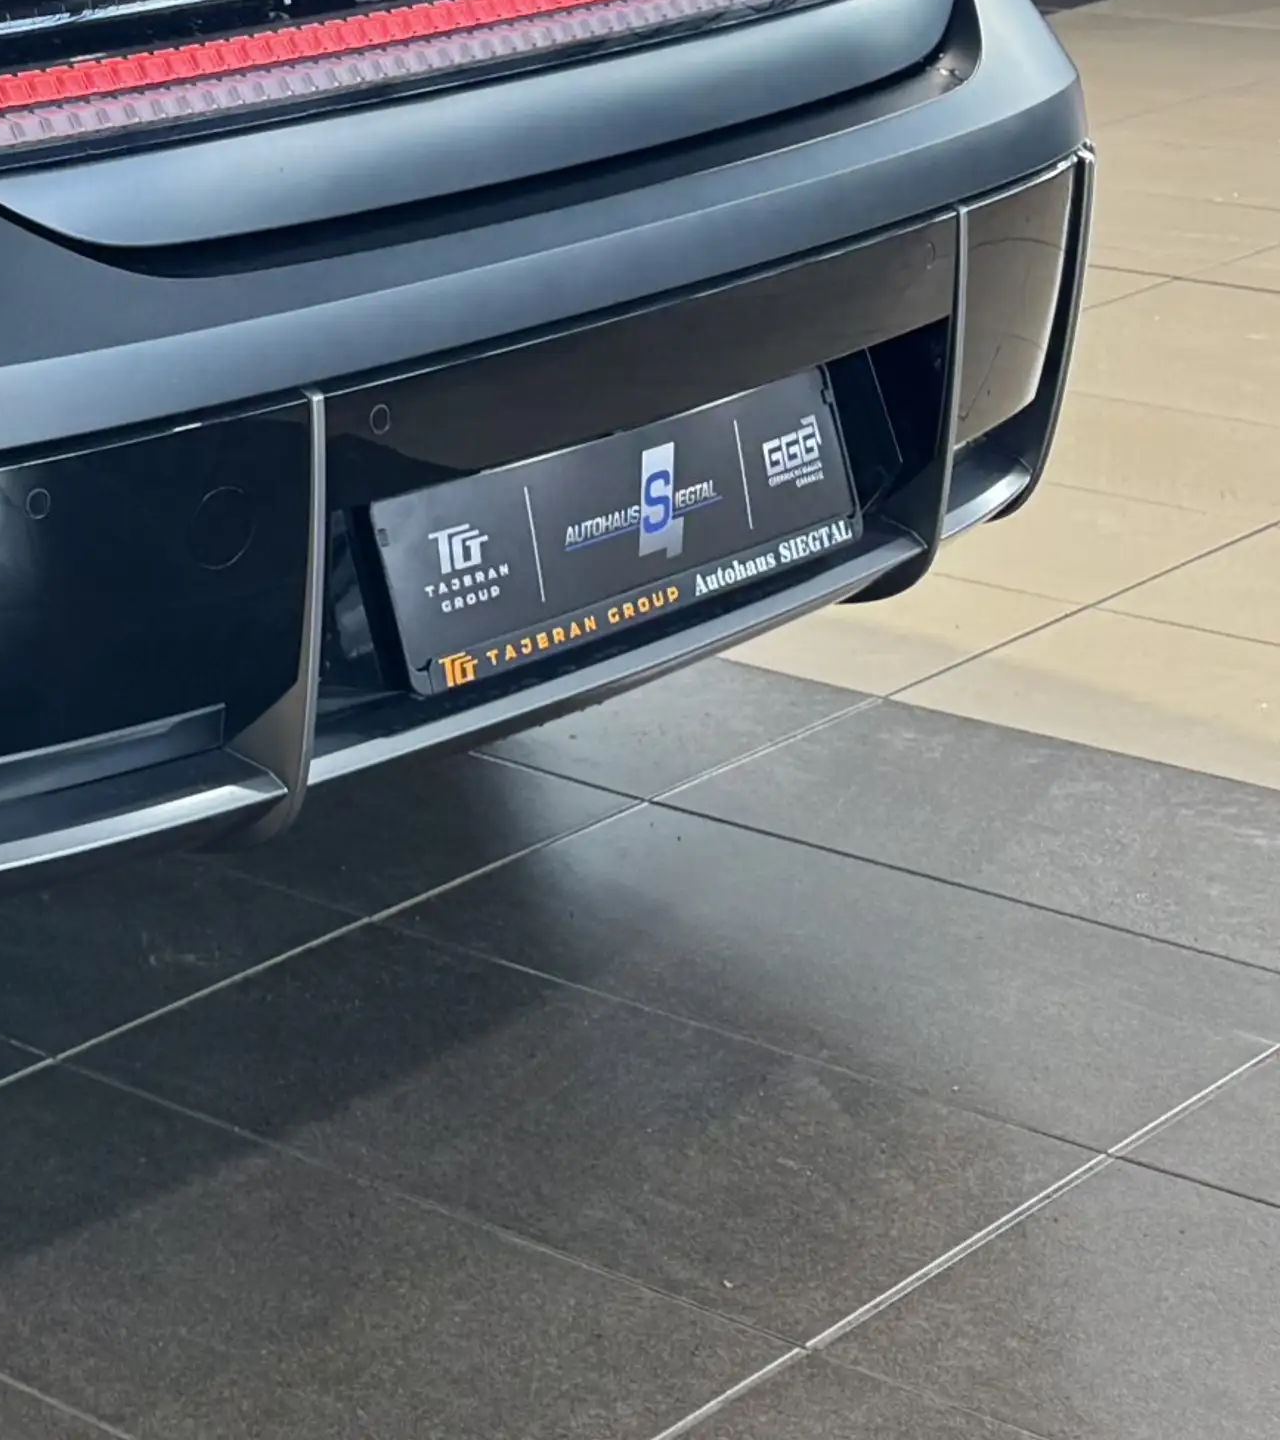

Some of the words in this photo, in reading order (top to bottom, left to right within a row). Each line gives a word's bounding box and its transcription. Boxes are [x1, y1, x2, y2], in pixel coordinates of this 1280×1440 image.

[565, 504, 641, 546] AUTOHAUS
[424, 563, 510, 598] TAJERAN
[441, 585, 501, 613] GROUP
[486, 615, 597, 666] TAJERAN
[607, 585, 679, 624] GROUP
[695, 552, 777, 596] Autohaus
[778, 520, 853, 563] SIEGTAL
